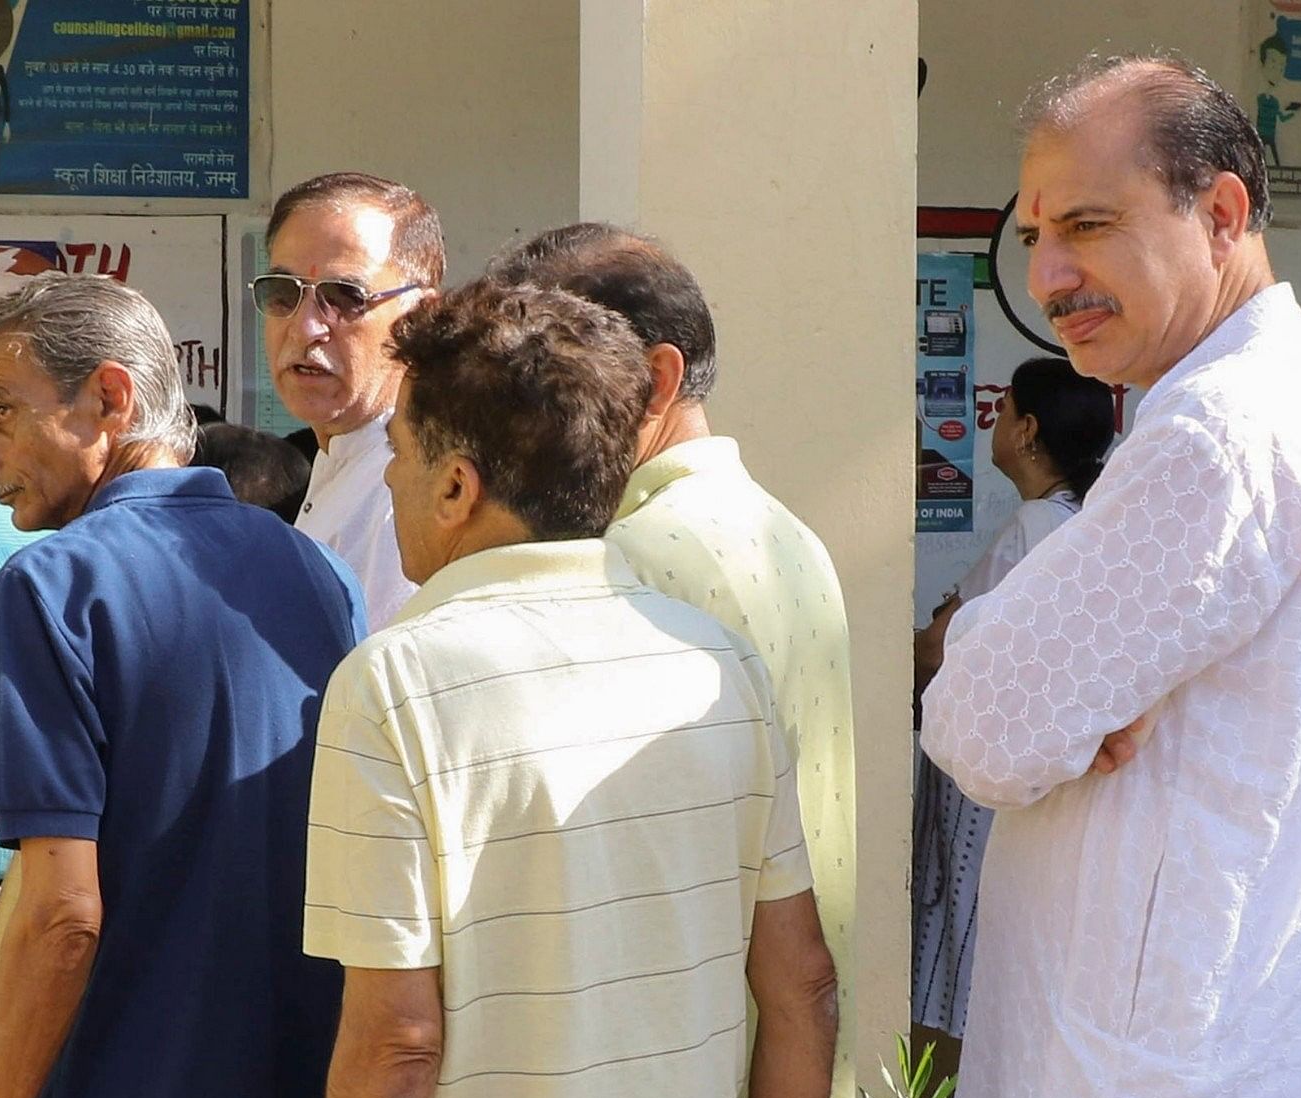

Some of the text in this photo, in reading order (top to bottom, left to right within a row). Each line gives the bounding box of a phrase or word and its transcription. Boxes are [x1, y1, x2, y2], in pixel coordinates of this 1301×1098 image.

[53, 167, 90, 191] स्कूल
[93, 162, 127, 186] शिक्षा
[203, 171, 240, 194] जम्मू
[921, 508, 964, 519] OF INDIA
